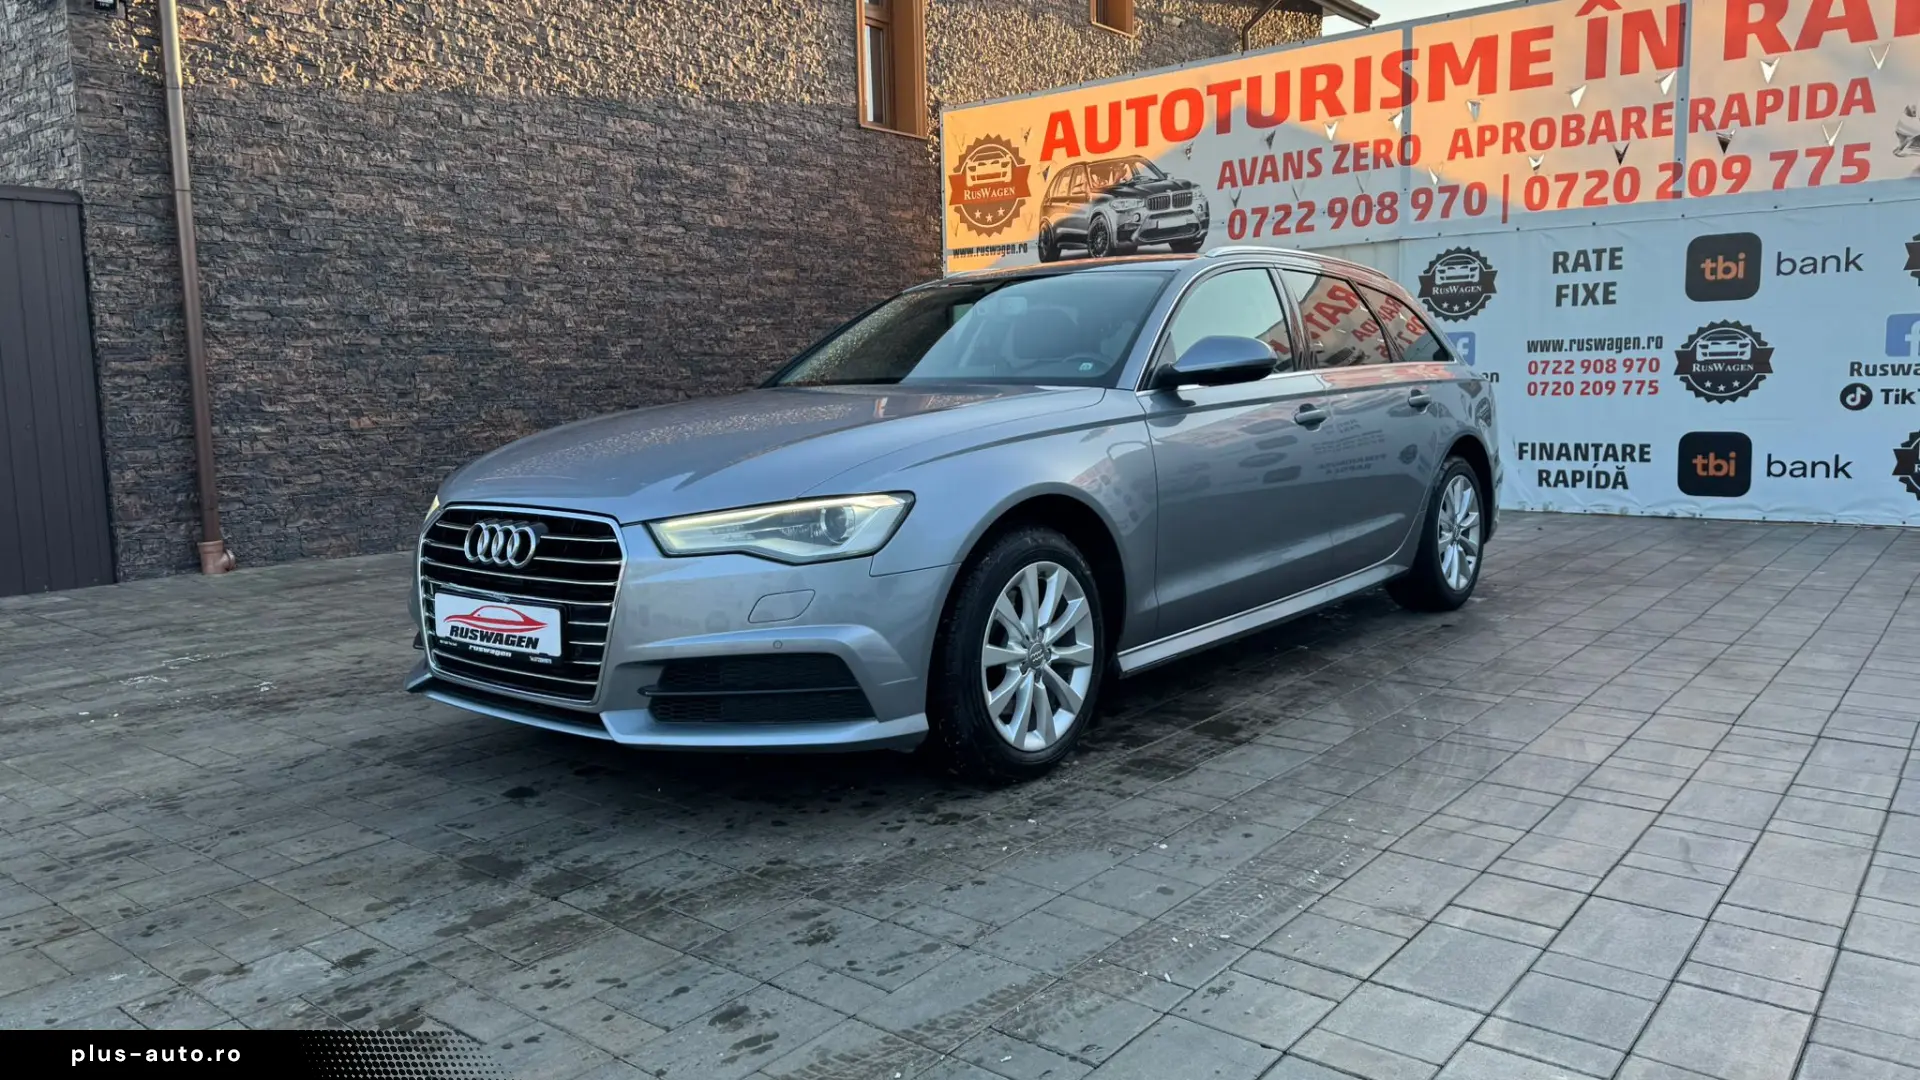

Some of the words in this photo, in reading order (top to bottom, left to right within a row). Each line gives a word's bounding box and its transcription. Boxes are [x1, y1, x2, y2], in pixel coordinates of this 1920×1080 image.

[1040, 24, 1554, 162] AUTOTURISME
[1575, 0, 1687, 80] ÎN
[1217, 147, 1323, 190] AVANS
[1331, 134, 1421, 175] ZERO
[1447, 102, 1674, 161] APROBARE
[1688, 77, 1876, 134] RAPIDA
[1227, 200, 1315, 240] 0722
[1327, 191, 1399, 230] 908
[1410, 182, 1487, 221] 970
[1524, 163, 1641, 212] 0720
[1656, 154, 1752, 199] 209
[1769, 142, 1871, 192] 775
[953, 243, 1028, 258] www.ruswagen.ro
[1552, 247, 1623, 274] RATE
[1701, 252, 1746, 281] tbi
[1776, 246, 1864, 276] bank
[1556, 281, 1617, 307] FIXE
[1527, 335, 1664, 354] www.ruswagen.ro
[1528, 359, 1575, 375] 0722
[1580, 358, 1617, 374] 908
[1622, 357, 1660, 373] 970
[1527, 381, 1574, 396] 0720
[1580, 380, 1616, 396] 209
[1622, 380, 1659, 395] 775
[1692, 451, 1736, 477] tbi
[1766, 453, 1853, 479] bank
[450, 625, 539, 650] RUSWAGEN
